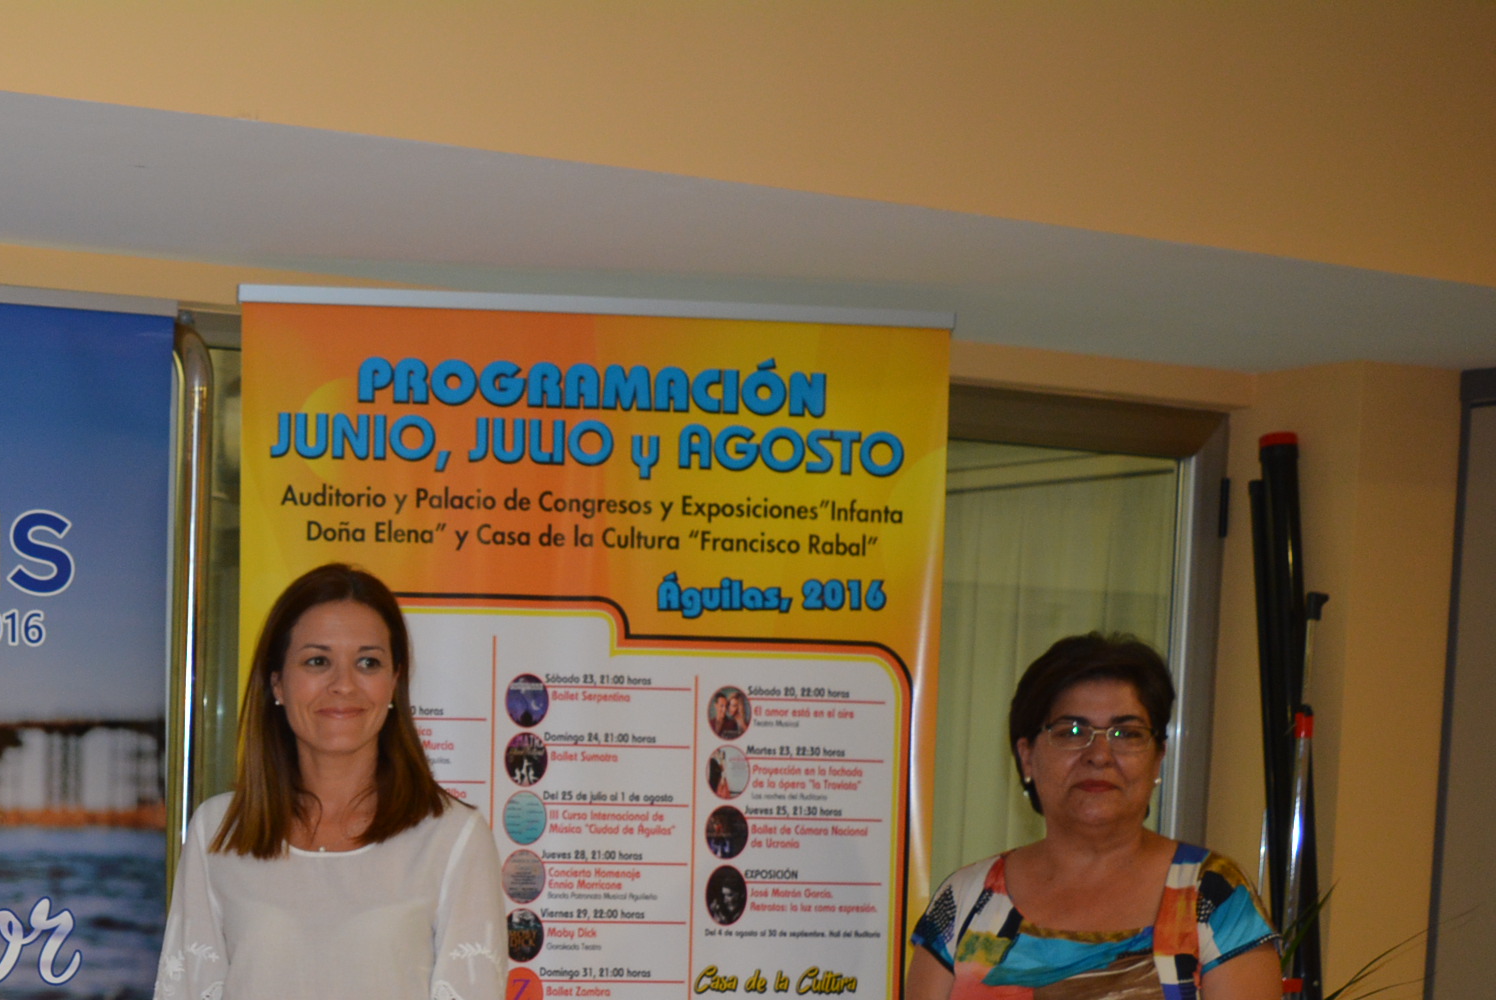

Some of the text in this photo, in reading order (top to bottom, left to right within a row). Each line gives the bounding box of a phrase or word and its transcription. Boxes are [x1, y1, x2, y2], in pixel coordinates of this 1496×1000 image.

[357, 355, 827, 418] PROGRAMACIÓN
[269, 412, 452, 472] JUNIO,
[467, 417, 615, 467] JULIO
[677, 424, 905, 477] AGOSTO
[281, 485, 387, 510] Auditorio
[394, 493, 408, 514] y
[415, 489, 497, 512] Palacio
[504, 492, 531, 512] de
[538, 493, 653, 518] Congresos
[660, 500, 674, 520] y
[305, 520, 367, 544] Doña
[454, 528, 469, 549] y
[476, 525, 530, 547] Casa
[538, 525, 566, 547] de
[573, 525, 594, 548] la
[601, 527, 680, 550] Cultura
[657, 572, 888, 620] Águilas, 2016
[545, 674, 651, 686] Sábado 23, 21:00 horas
[423, 740, 454, 751] Murcia
[545, 732, 656, 744] Domingo 24, 21:00 horas
[541, 909, 645, 919] Viernes 29, 22:00 horas
[547, 928, 597, 939] Moby Dick
[694, 965, 858, 995] Casa de la Cultura
